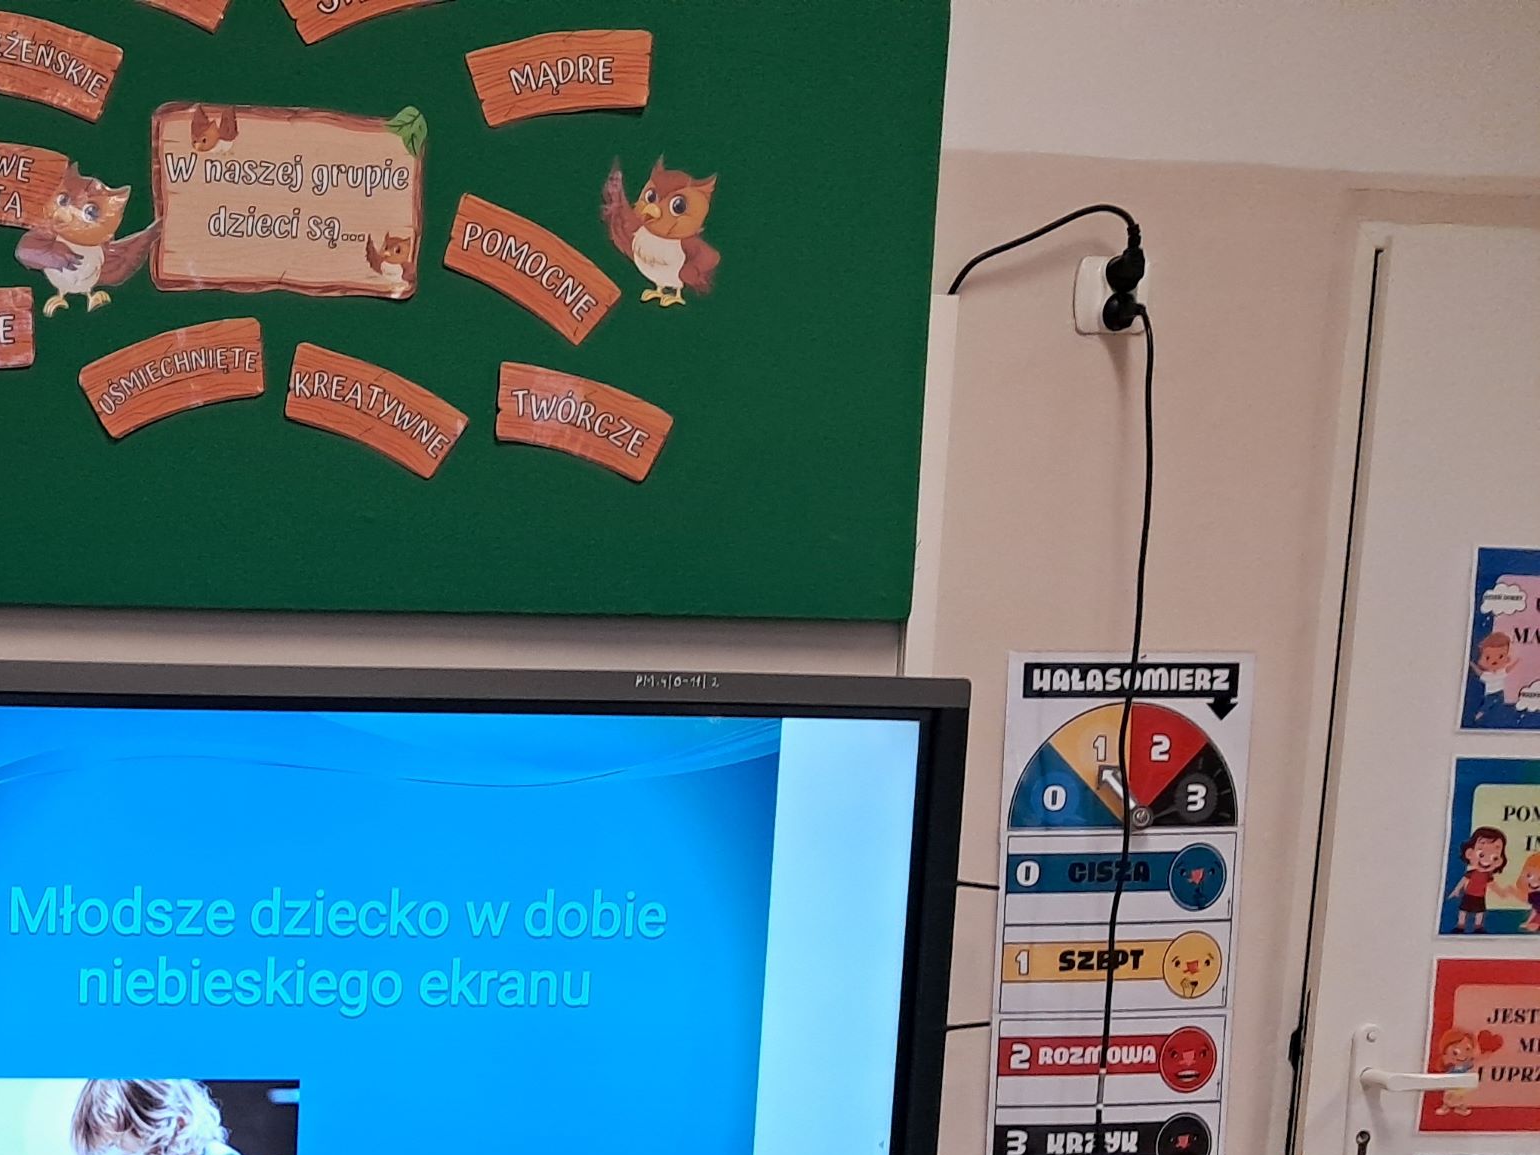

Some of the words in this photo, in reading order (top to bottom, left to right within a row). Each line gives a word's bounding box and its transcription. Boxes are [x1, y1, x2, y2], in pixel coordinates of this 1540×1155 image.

[508, 55, 615, 96] MĄDRE
[164, 153, 192, 184] W
[204, 155, 304, 193] naszej
[311, 158, 410, 197] grupie
[207, 205, 298, 240] dzieci
[461, 221, 597, 323] POMOCNE
[98, 346, 260, 416] UŚMIECHNIĘTE
[294, 370, 451, 459] KREATYWNE
[512, 388, 650, 459] TWÓRCZE
[1093, 735, 1107, 762] 1
[1150, 734, 1172, 762] 2
[1186, 783, 1207, 812] 3
[8, 884, 236, 937] Młodsze
[250, 887, 450, 938] dziecko
[465, 900, 509, 936] w
[524, 889, 668, 938] dobie
[1015, 949, 1030, 975] 1
[78, 956, 403, 1017] niebieskiego
[419, 958, 591, 1006] ekranu
[1010, 1043, 1032, 1070] 2
